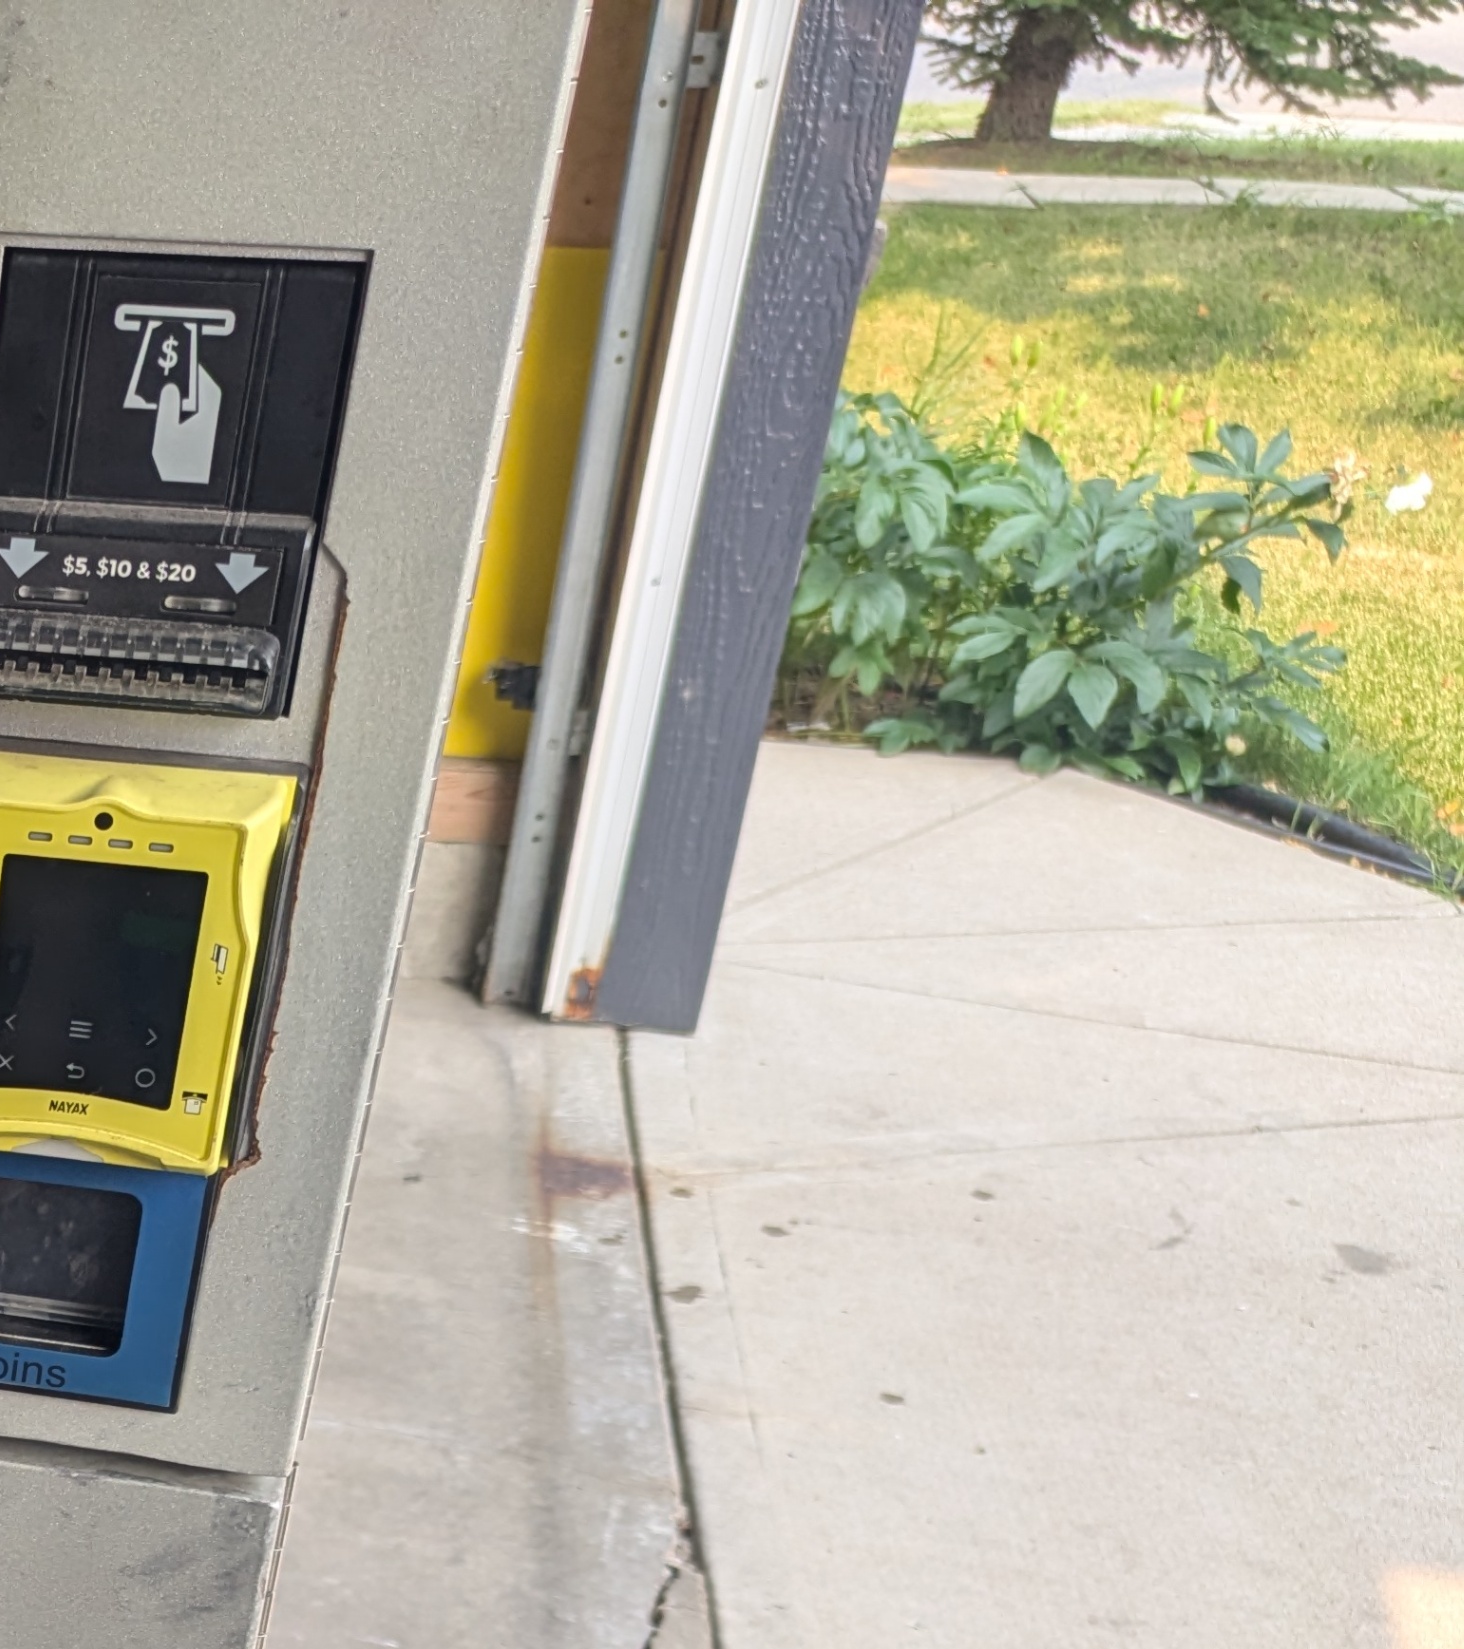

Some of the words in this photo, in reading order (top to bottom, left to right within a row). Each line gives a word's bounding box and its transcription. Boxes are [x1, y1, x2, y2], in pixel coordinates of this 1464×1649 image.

[62, 553, 91, 578] $5,
[96, 556, 133, 579] $10
[136, 560, 151, 580] &
[155, 560, 197, 583] $20
[48, 1099, 90, 1115] NAYAX
